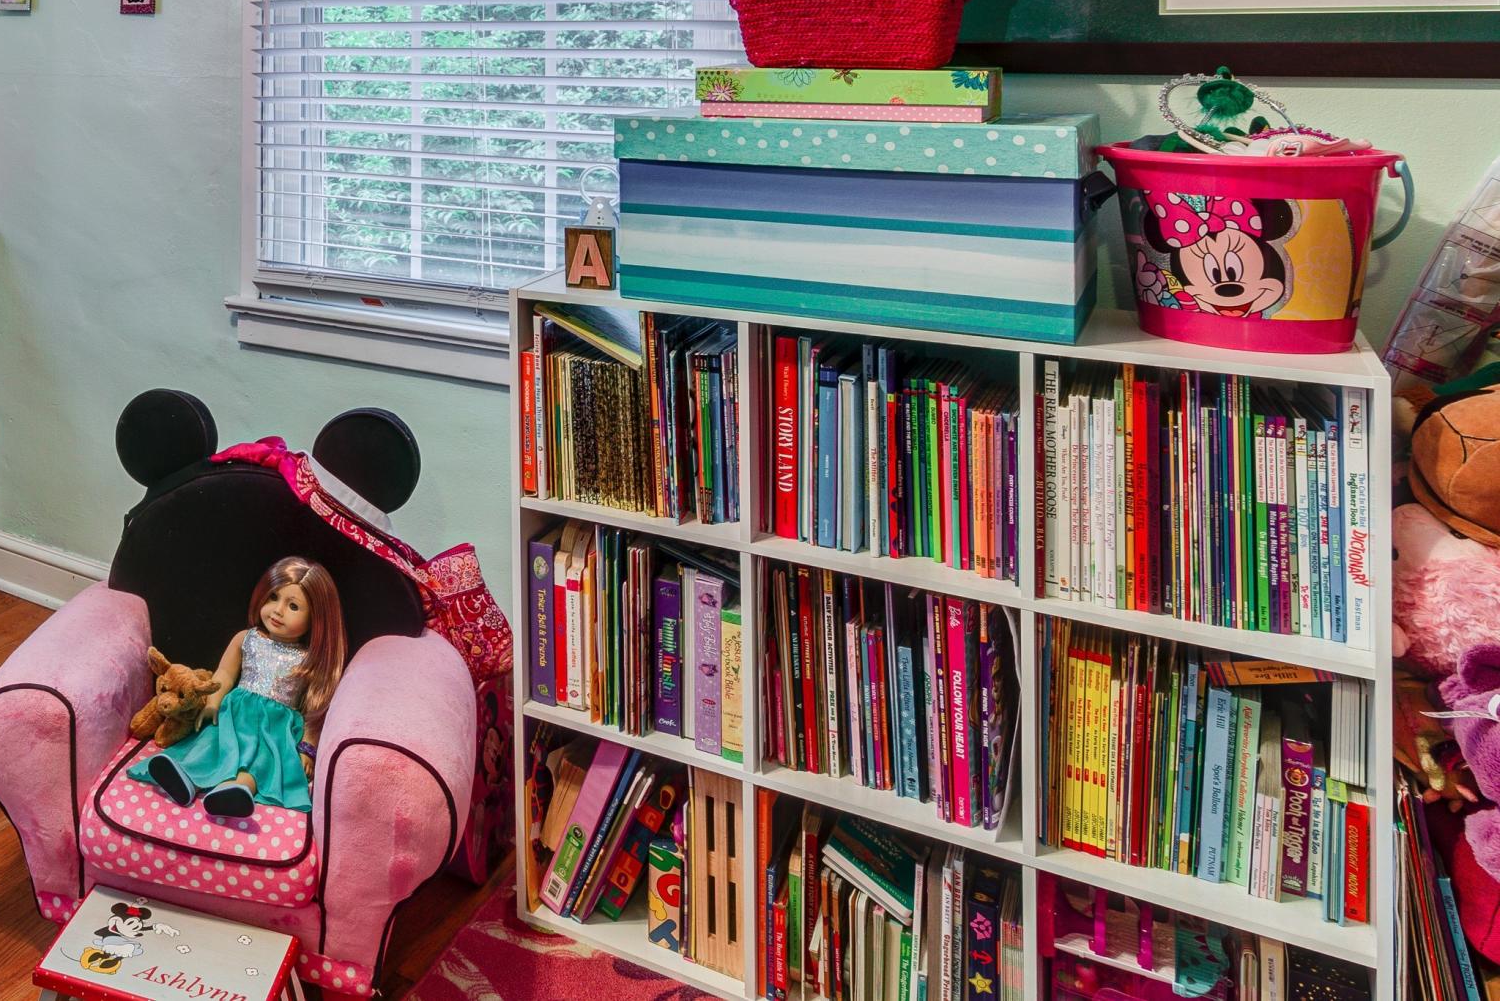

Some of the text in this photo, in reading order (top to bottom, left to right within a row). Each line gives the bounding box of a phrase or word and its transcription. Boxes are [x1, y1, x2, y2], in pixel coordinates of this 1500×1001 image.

[567, 234, 610, 286] A
[779, 407, 793, 451] STORY
[1046, 371, 1057, 519] THE REAL MOTHER GOOSE
[779, 454, 794, 492] LAND
[1070, 487, 1078, 506] Scrape
[1347, 473, 1359, 526] Beginner Book
[1072, 509, 1080, 523] Their
[1082, 509, 1090, 523] Their
[1270, 511, 1278, 526] Miles
[1279, 512, 1287, 520] Oh,
[1280, 522, 1288, 532] the
[1270, 528, 1278, 538] and
[1280, 534, 1288, 546] Pets
[1258, 541, 1268, 560] Beyond
[1270, 540, 1278, 555] Miles
[1348, 530, 1369, 586] DICTIONARY
[1258, 562, 1268, 578] Bugs!
[1270, 564, 1278, 586] Reptiles
[538, 588, 546, 612] Tinker
[949, 606, 961, 628] Barbie
[1355, 598, 1363, 630] Eastman
[662, 617, 677, 654] Family
[702, 613, 716, 657] Holy Bible
[724, 638, 733, 700] Storybook Bible
[952, 670, 962, 706] FOLLOW
[903, 691, 911, 711] Kittens
[1243, 706, 1252, 720] Kids'
[954, 707, 963, 731] YOUR
[956, 732, 964, 758] HEART
[1242, 722, 1252, 750] Favorites
[1238, 750, 1250, 779] Storybook
[1207, 698, 1227, 876] Eric Hill Spot's Balloon PUTNAM
[1239, 781, 1247, 808] Collection
[1285, 790, 1308, 816] Pooh
[1312, 798, 1322, 807] Put
[1313, 810, 1320, 819] Me
[1238, 810, 1246, 830] Volume
[1283, 825, 1306, 863] Tigger
[1348, 825, 1359, 896] GOODNIGHT MOON
[1310, 862, 1318, 886] Lopshire
[776, 943, 784, 956] Busy
[1462, 964, 1473, 988] FROZEN
